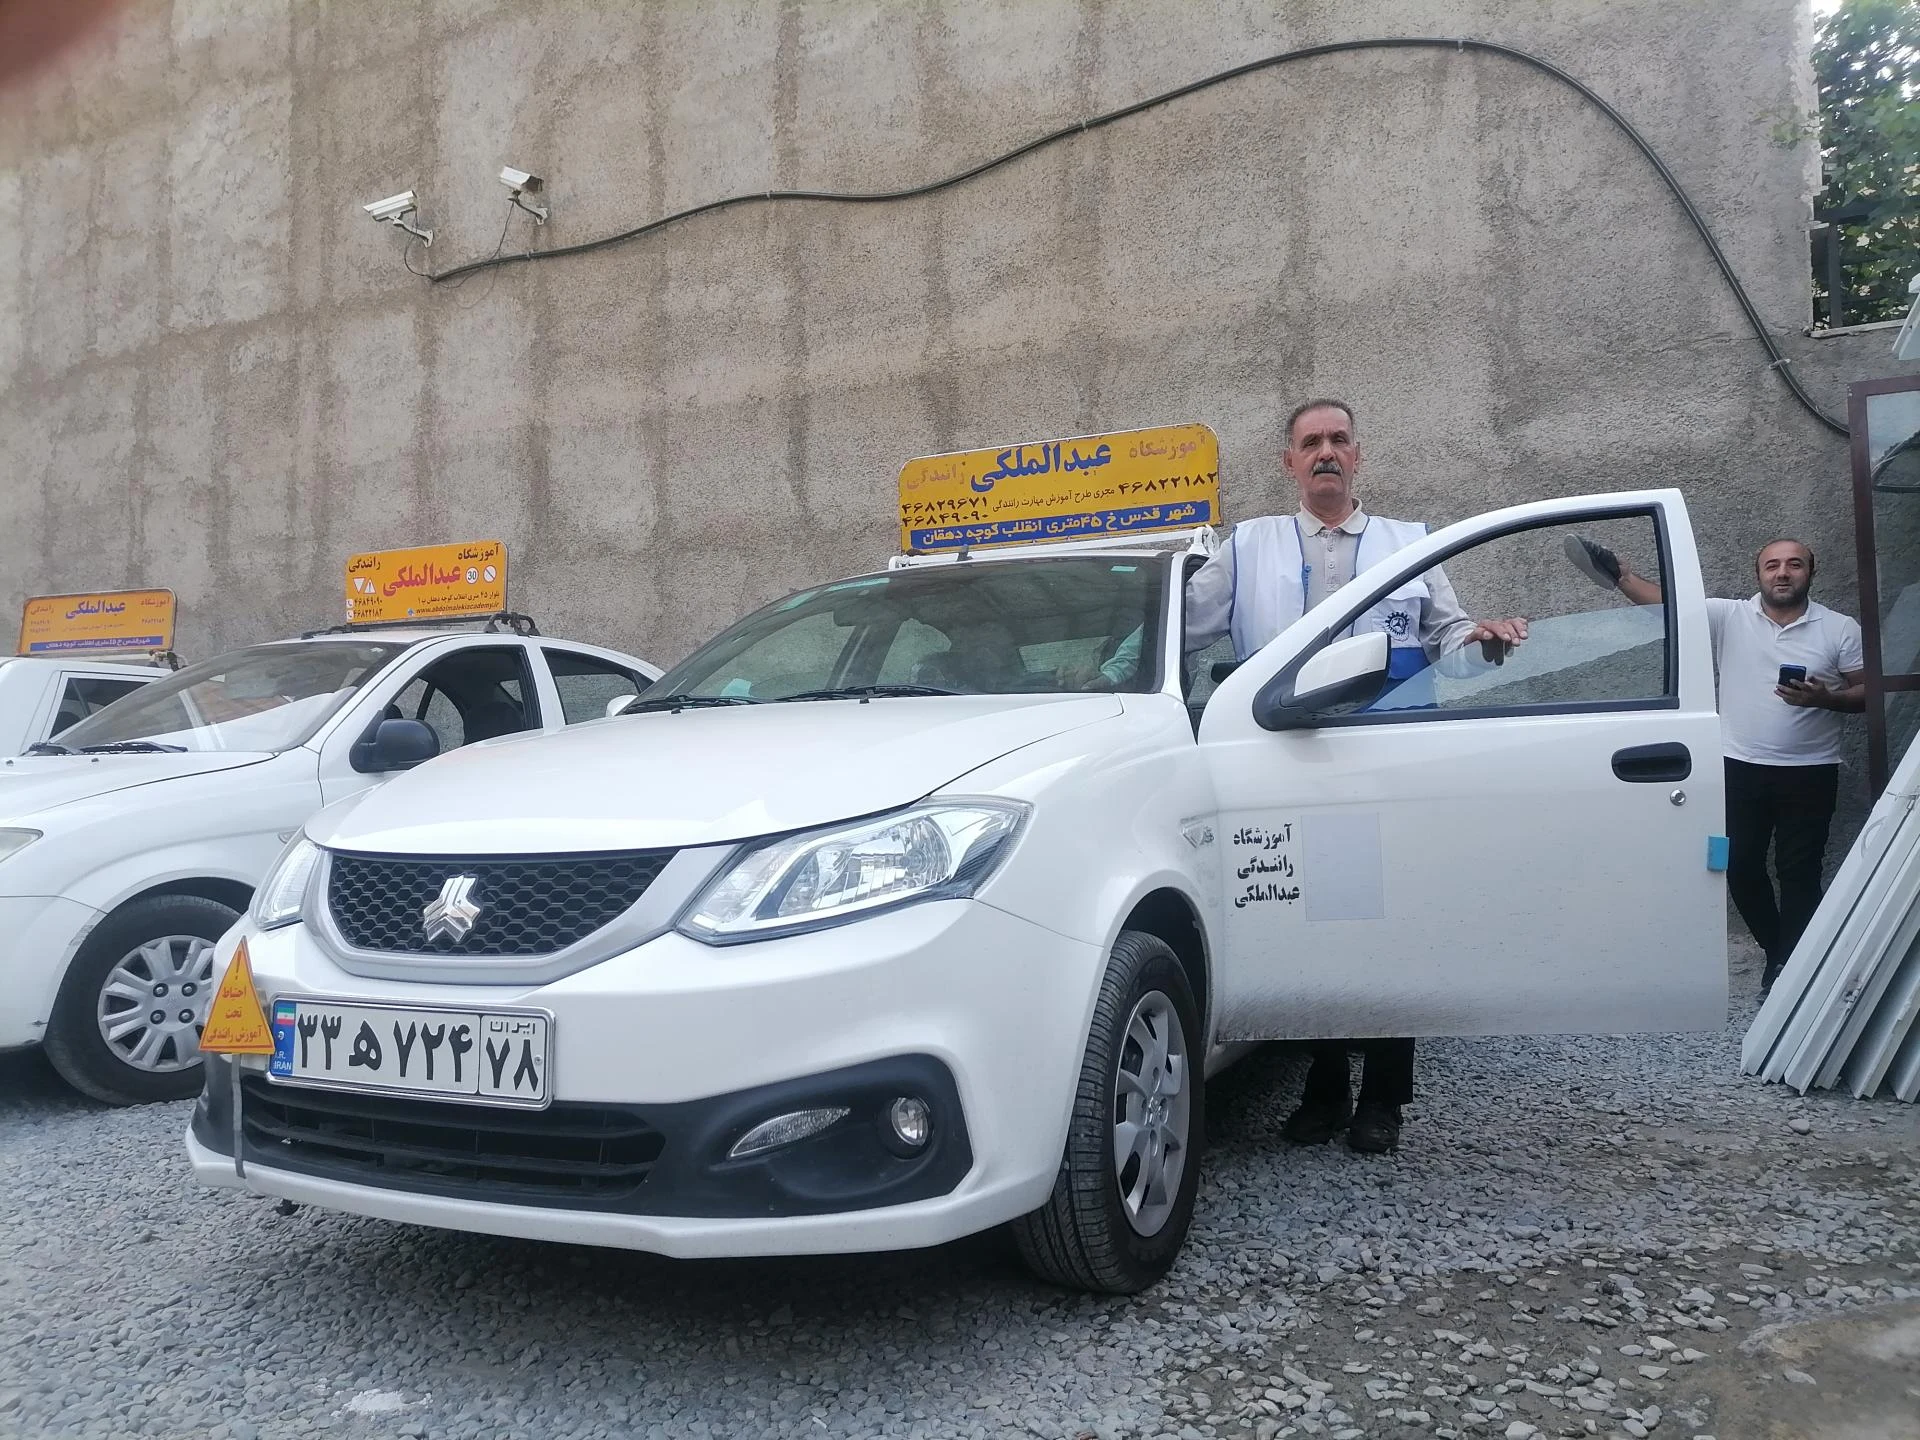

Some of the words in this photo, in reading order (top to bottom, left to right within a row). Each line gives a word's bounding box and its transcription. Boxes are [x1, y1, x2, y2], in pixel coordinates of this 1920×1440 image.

[970, 442, 1111, 492] عبدالملکی
[1118, 471, 1217, 495] ۴۶۸۲۲۱۸۲
[1021, 495, 1044, 507] مهارت
[1046, 489, 1072, 506] آموزش
[1074, 490, 1092, 503] طرح
[1093, 487, 1115, 499] مجری
[901, 496, 988, 514] ۴۶۸۲۹۶۷۱
[992, 498, 1019, 512] رانندگی
[1164, 503, 1196, 522] شهر
[902, 510, 989, 527] ۴۶۸۴۹۰۹۰
[1105, 512, 1118, 531] خ
[1120, 507, 1161, 526] قدس
[922, 528, 963, 545] دهقان
[966, 523, 999, 543] کوچه
[1002, 520, 1042, 537] انقلاب
[458, 542, 500, 562] آموزشگاه
[348, 556, 381, 573] رانندگی
[382, 563, 461, 597] عبدالملکی
[65, 599, 126, 619] عبدالملکی
[1233, 823, 1292, 849] آموزشگاه
[1237, 854, 1294, 879] رانندگی
[222, 985, 247, 999] احتیاط
[225, 1006, 243, 1019] تحت
[207, 1027, 233, 1043] رانندگی
[235, 1024, 262, 1043] آموزش
[489, 1019, 537, 1036] ایران
[273, 1060, 292, 1070] IRAN
[485, 1036, 540, 1092] ۷۸
